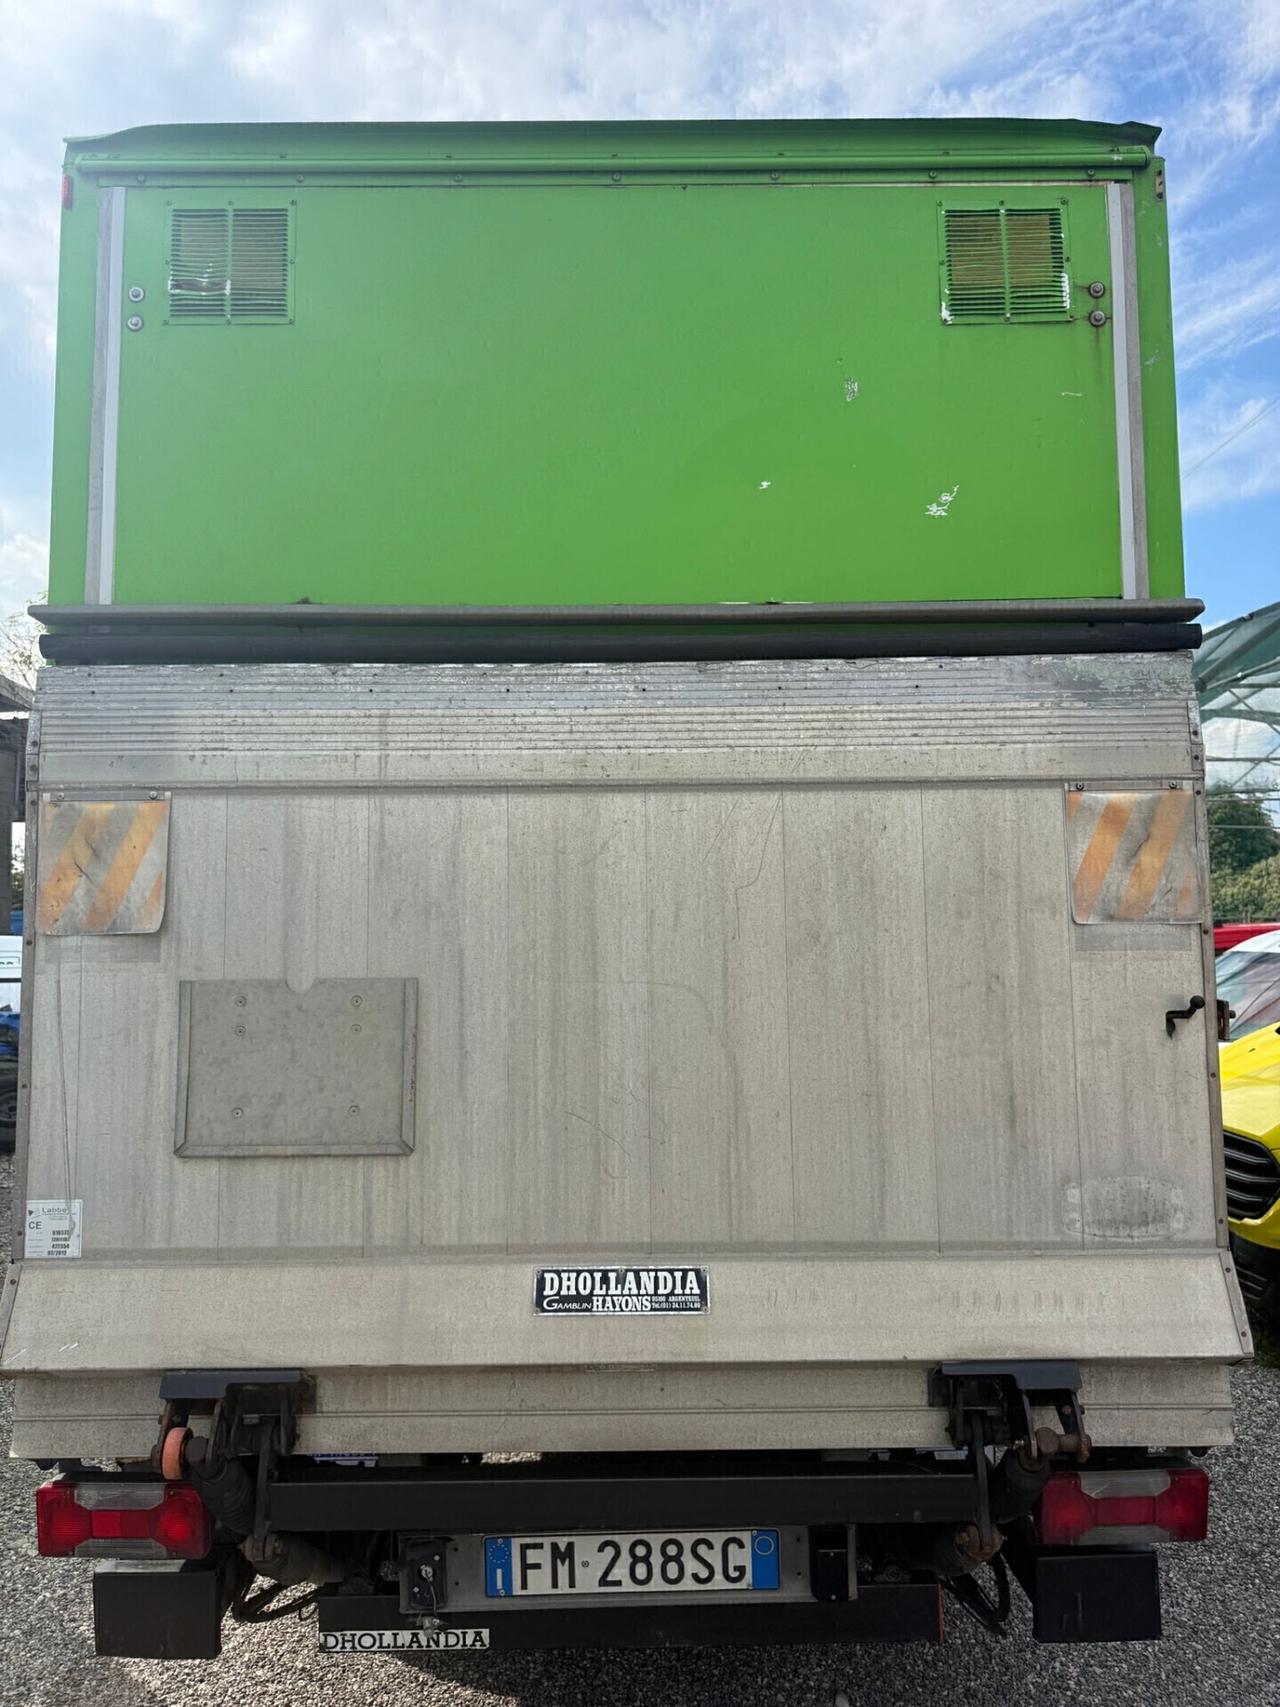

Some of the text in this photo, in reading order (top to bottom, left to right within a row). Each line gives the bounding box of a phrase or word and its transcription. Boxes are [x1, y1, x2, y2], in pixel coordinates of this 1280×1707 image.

[28, 1221, 42, 1230] CE
[543, 1271, 700, 1295] DHOLLANDIA
[592, 1296, 651, 1311] HAYONS
[519, 1541, 576, 1590] FM
[597, 1536, 747, 1587] 288SG
[322, 1630, 488, 1650] DHOLLANDIA
